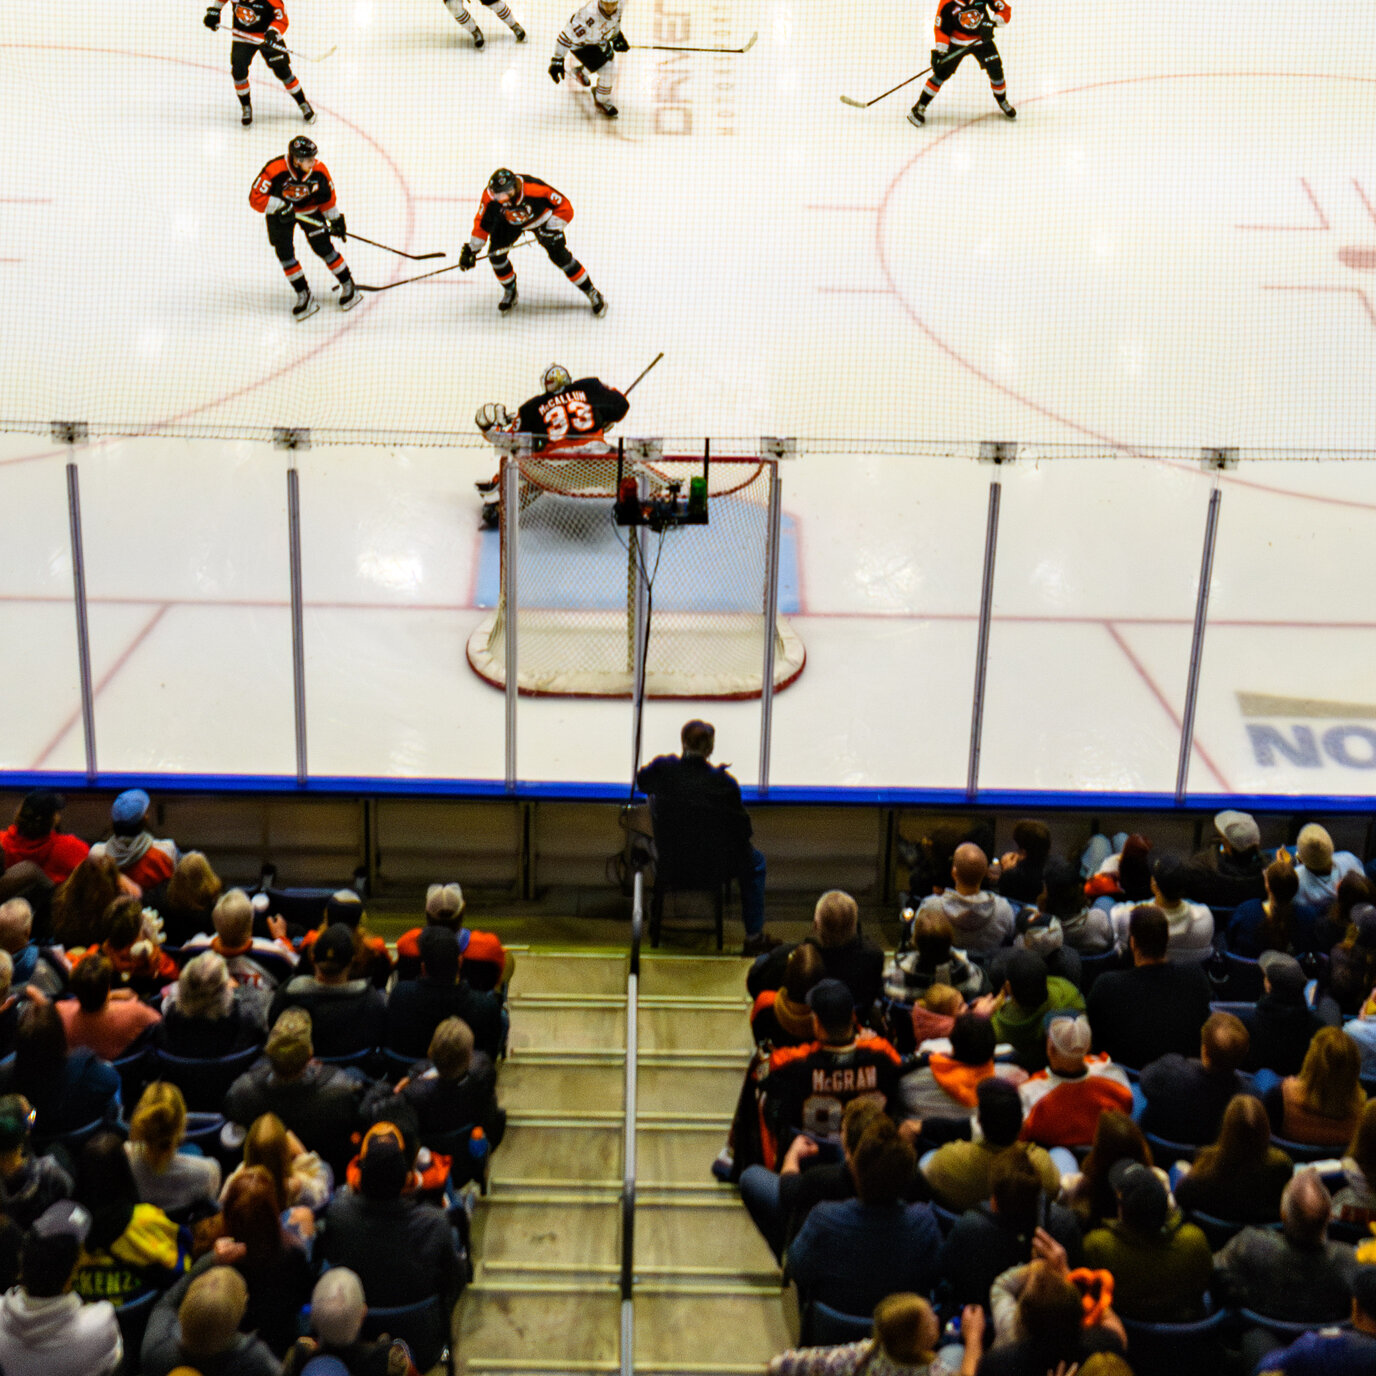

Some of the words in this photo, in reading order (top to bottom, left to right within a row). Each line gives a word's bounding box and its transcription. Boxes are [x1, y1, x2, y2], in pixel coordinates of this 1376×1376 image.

[253, 176, 273, 194] 15
[538, 390, 587, 416] McCALLUM
[544, 400, 595, 443] 33
